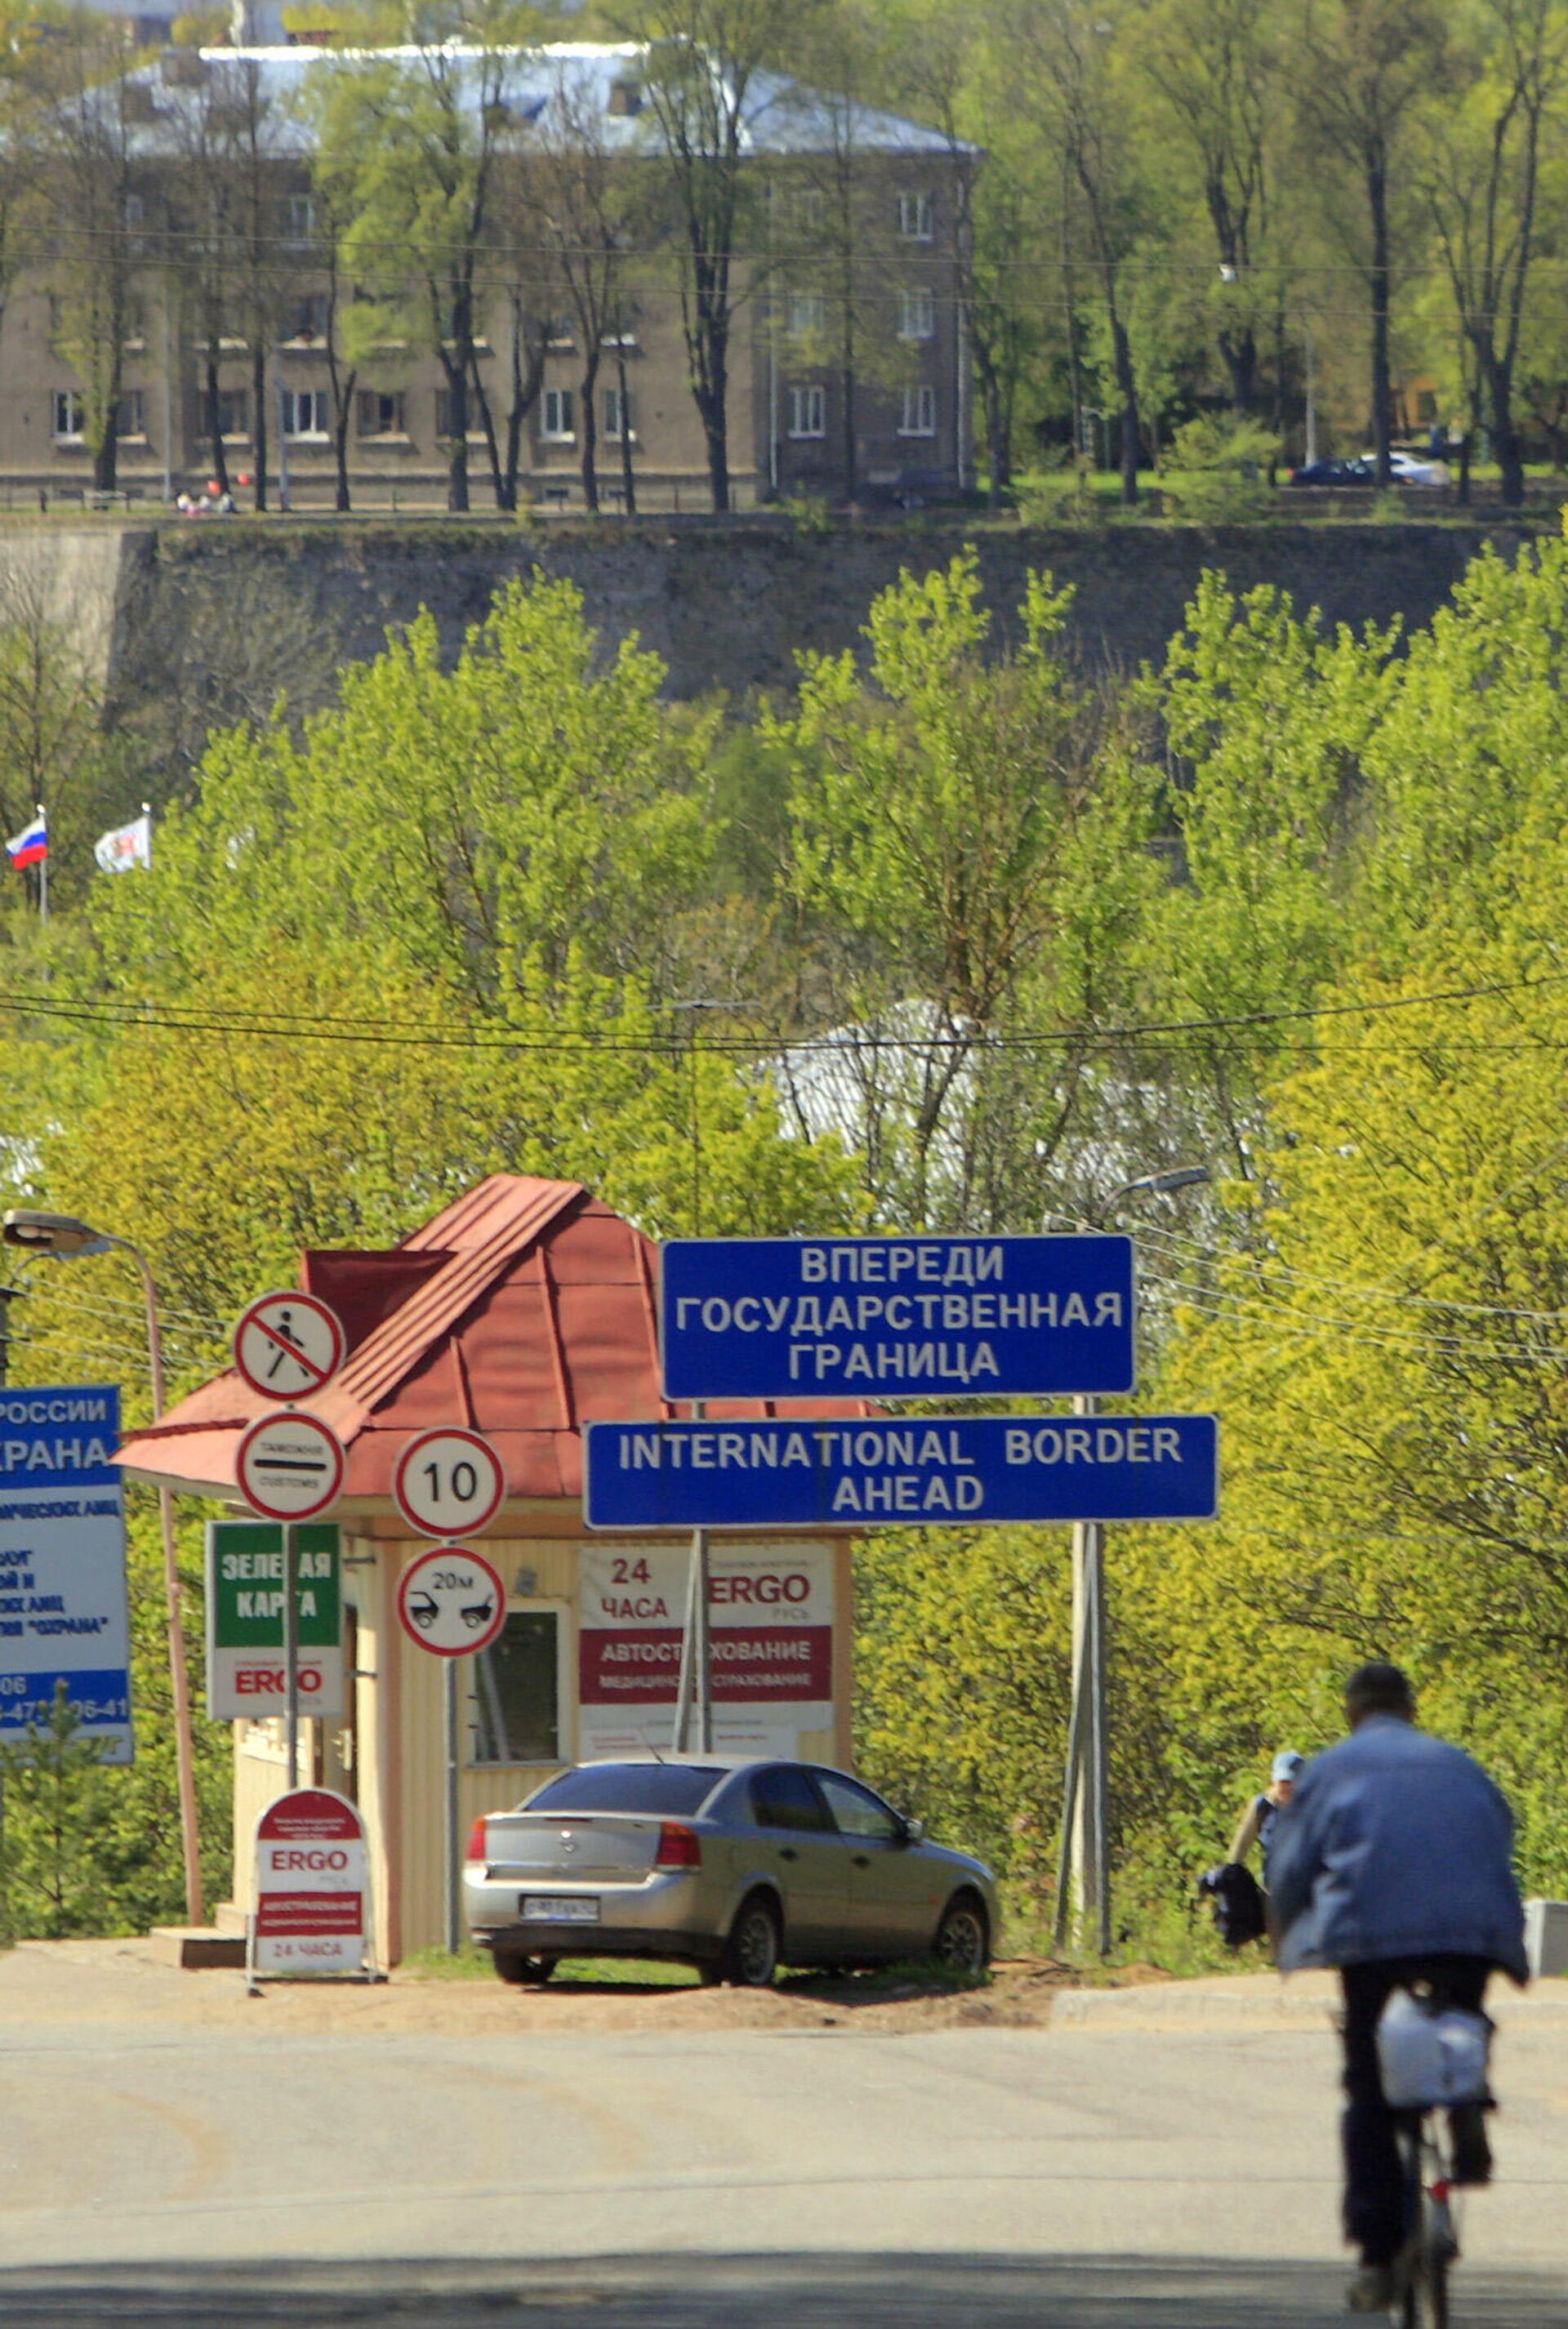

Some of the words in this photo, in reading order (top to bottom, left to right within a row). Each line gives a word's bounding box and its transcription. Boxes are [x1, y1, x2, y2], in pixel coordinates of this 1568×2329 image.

[800, 1245, 1004, 1287] ВПЕРЕДИ
[676, 1291, 1122, 1336] ГОСУДАРСТВЕННАЯ
[789, 1341, 1000, 1383] ГРАНИЦА
[0, 1438, 109, 1472] РАНА
[619, 1430, 974, 1470] INTERNATIONAL
[1005, 1427, 1183, 1464] BORDER
[424, 1462, 476, 1502] 10
[831, 1475, 984, 1512] AHEAD
[221, 1552, 332, 1581] ЗЕЛЕАЯ
[612, 1558, 653, 1584] 24
[707, 1574, 811, 1604] ERGO
[237, 1592, 318, 1618] КАРА
[601, 1598, 669, 1619] ЧАСА
[600, 1641, 812, 1662] АВТОСТХОВАНИЕ
[599, 1676, 702, 1689] МЕДИЦИНС
[271, 1850, 348, 1871] ERGO
